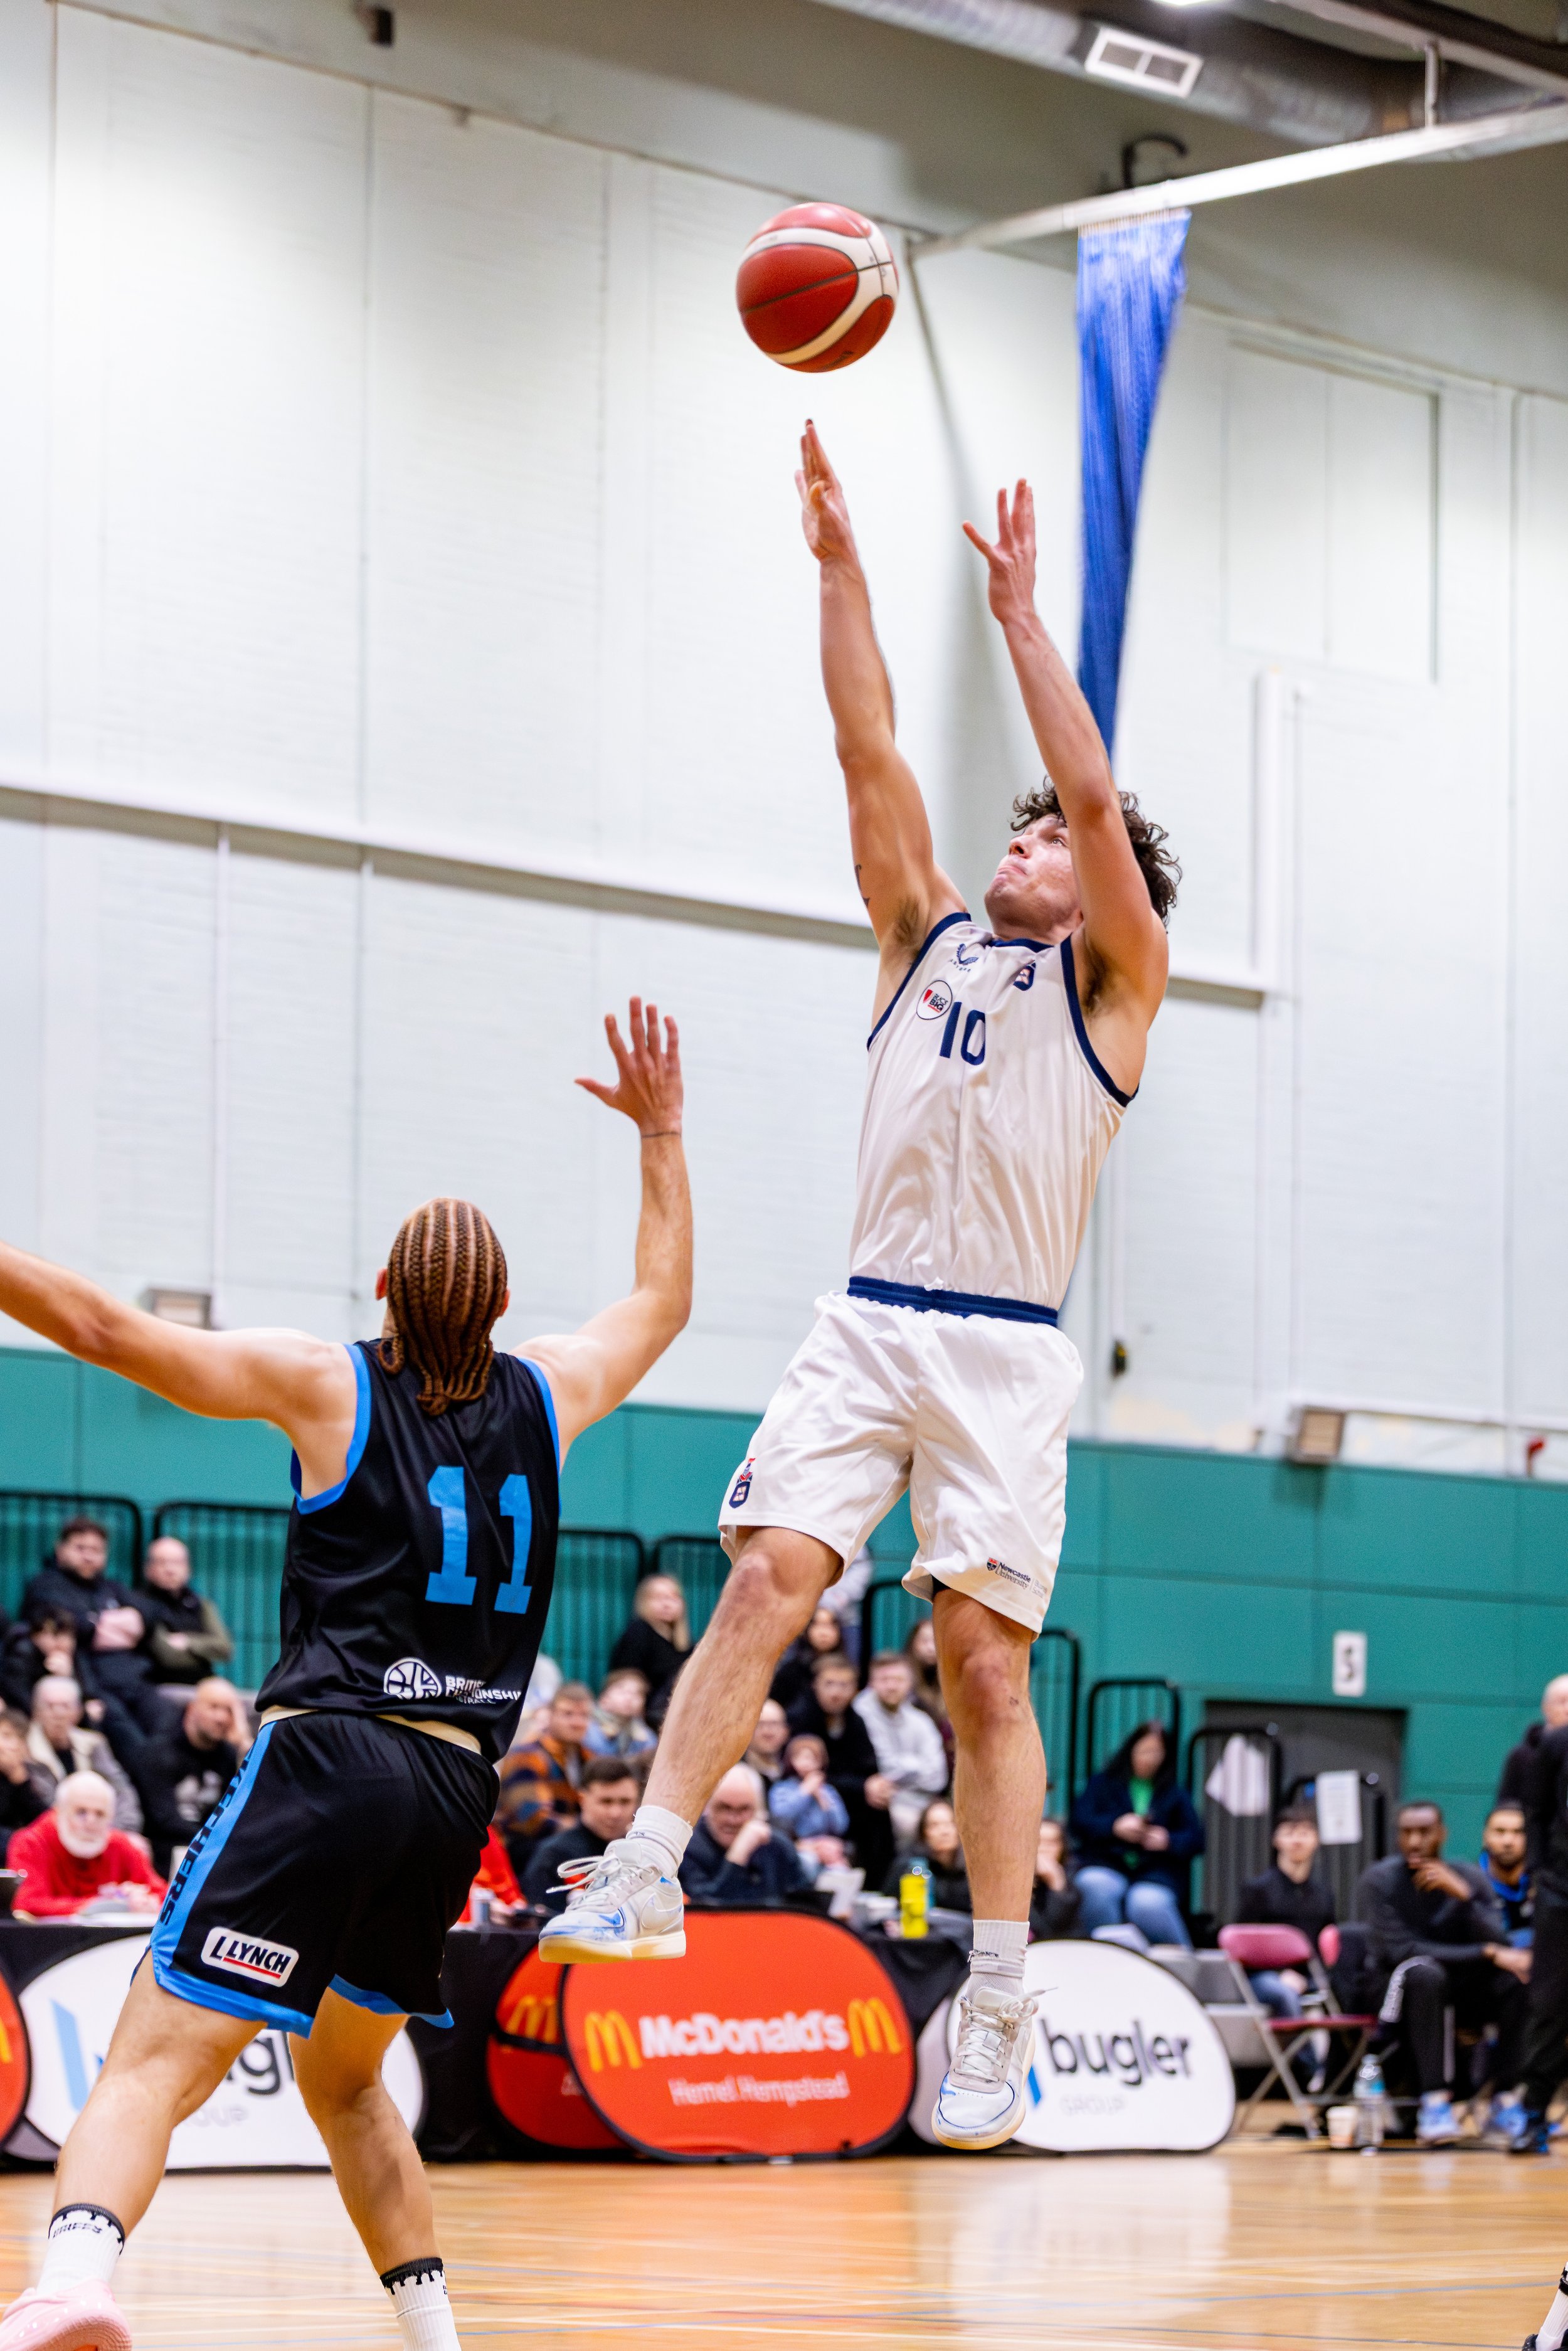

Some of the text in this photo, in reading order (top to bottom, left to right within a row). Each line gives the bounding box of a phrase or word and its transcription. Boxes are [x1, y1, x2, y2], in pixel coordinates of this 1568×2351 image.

[940, 1001, 986, 1066] 10
[425, 1464, 532, 1615] 11
[995, 1568, 1029, 1590] University
[999, 1562, 1031, 1583] Newcastle
[638, 2010, 849, 2059] McDonald's
[1040, 2018, 1192, 2086] bugler
[668, 2071, 850, 2108] Hemel Hempstead
